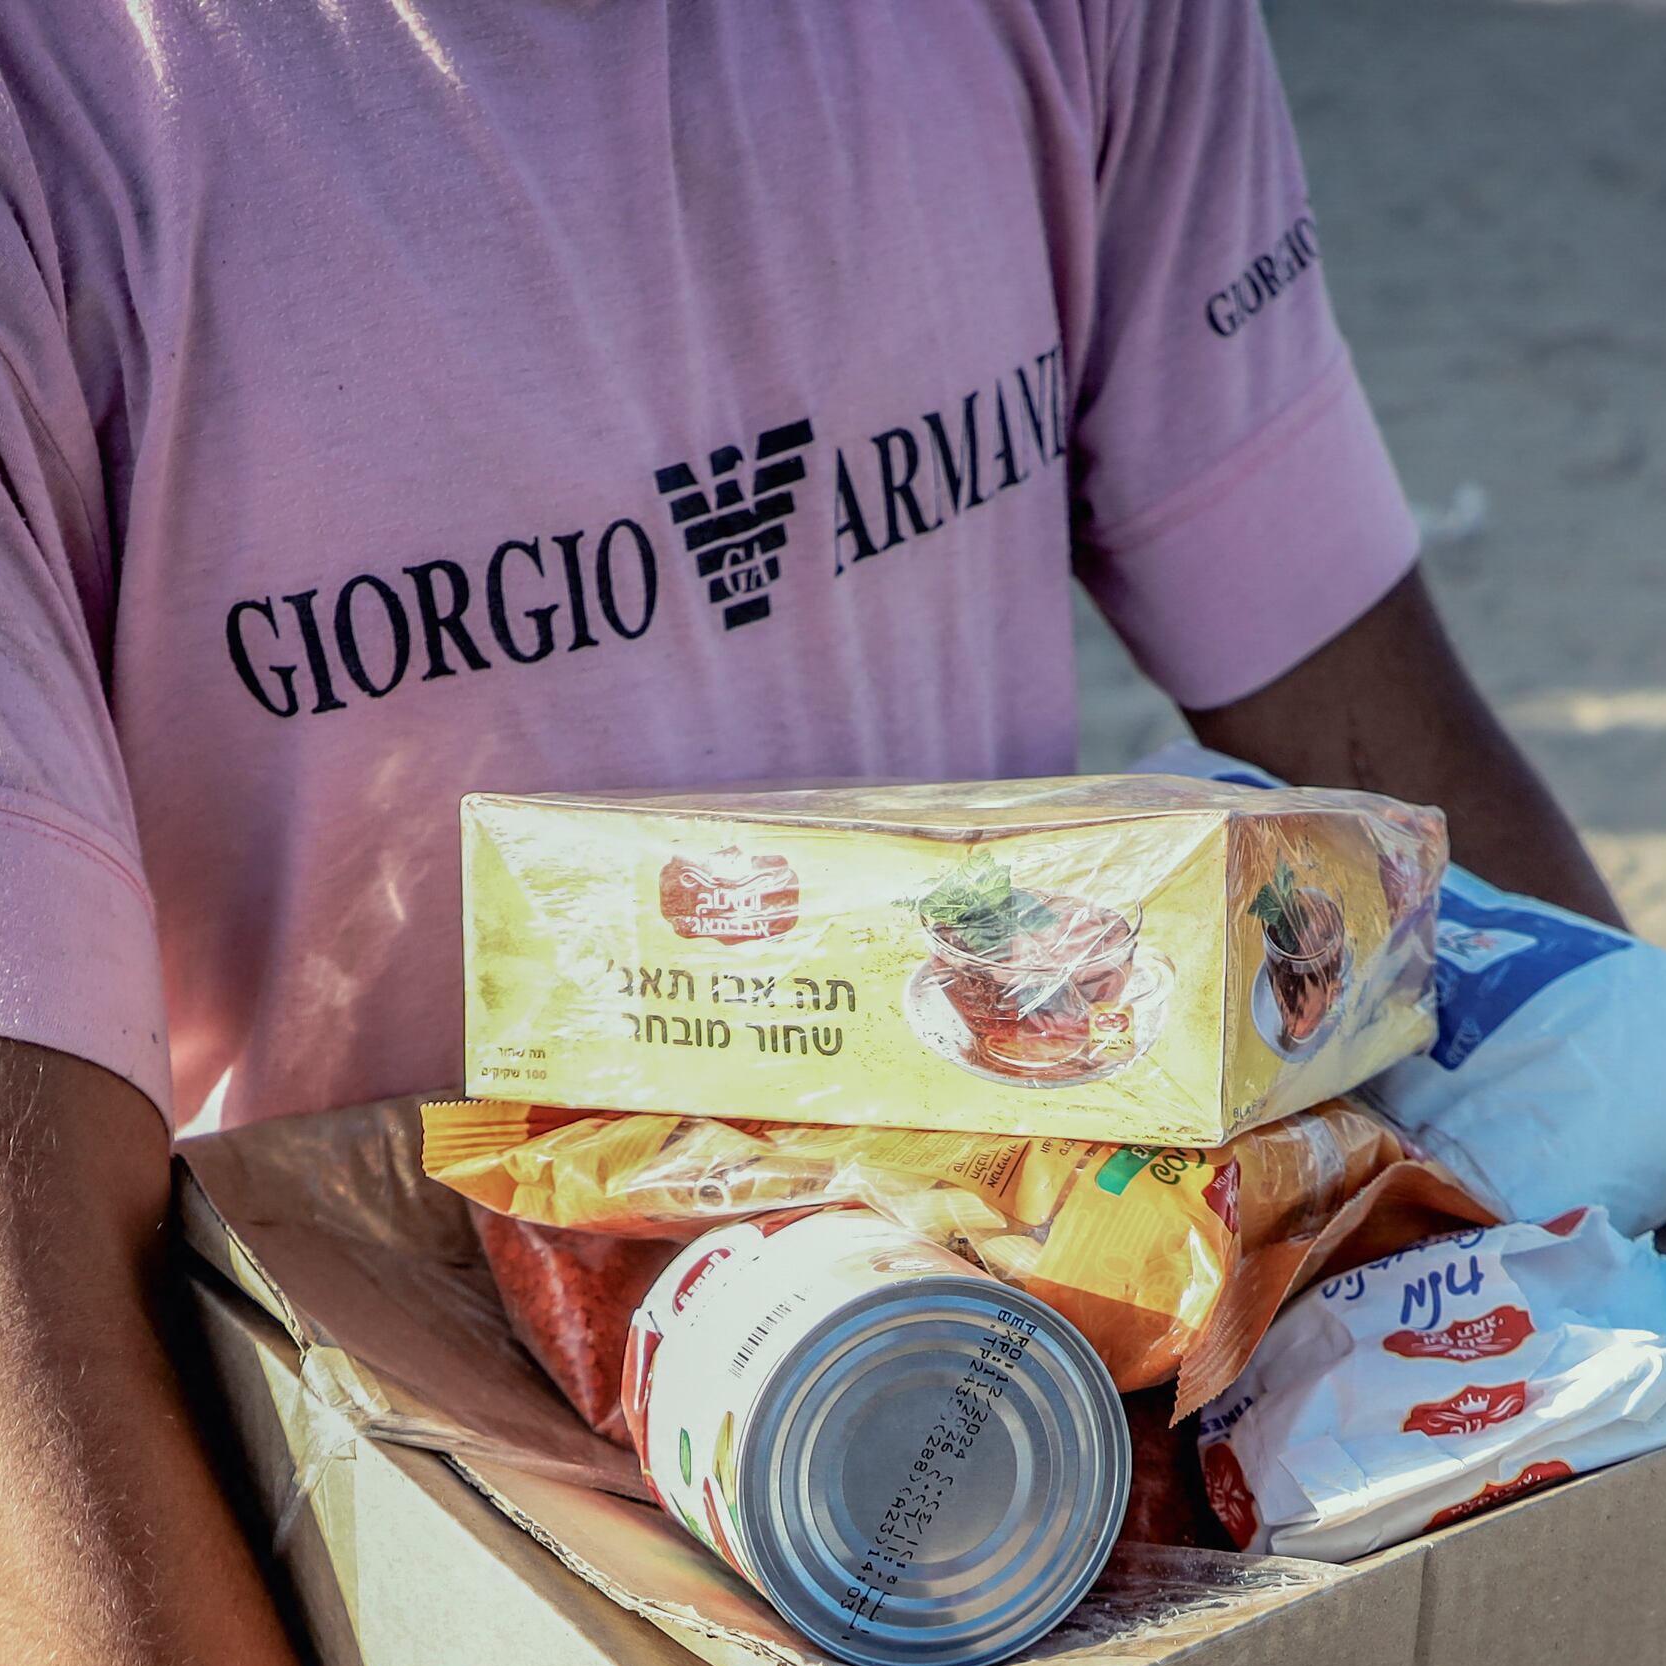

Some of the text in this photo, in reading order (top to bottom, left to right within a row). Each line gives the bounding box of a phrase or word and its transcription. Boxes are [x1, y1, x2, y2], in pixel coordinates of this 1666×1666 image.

[226, 345, 1066, 719] GIORGIO ARMANI
[711, 972, 776, 1008] אבו
[793, 977, 856, 1012] תה
[528, 1048, 546, 1059] תה
[621, 1012, 843, 1056] שחור מובחר
[525, 1069, 547, 1080] 100
[938, 1312, 1025, 1457] EXP:11/2026
[952, 1319, 1038, 1464] PRO:12/2024
